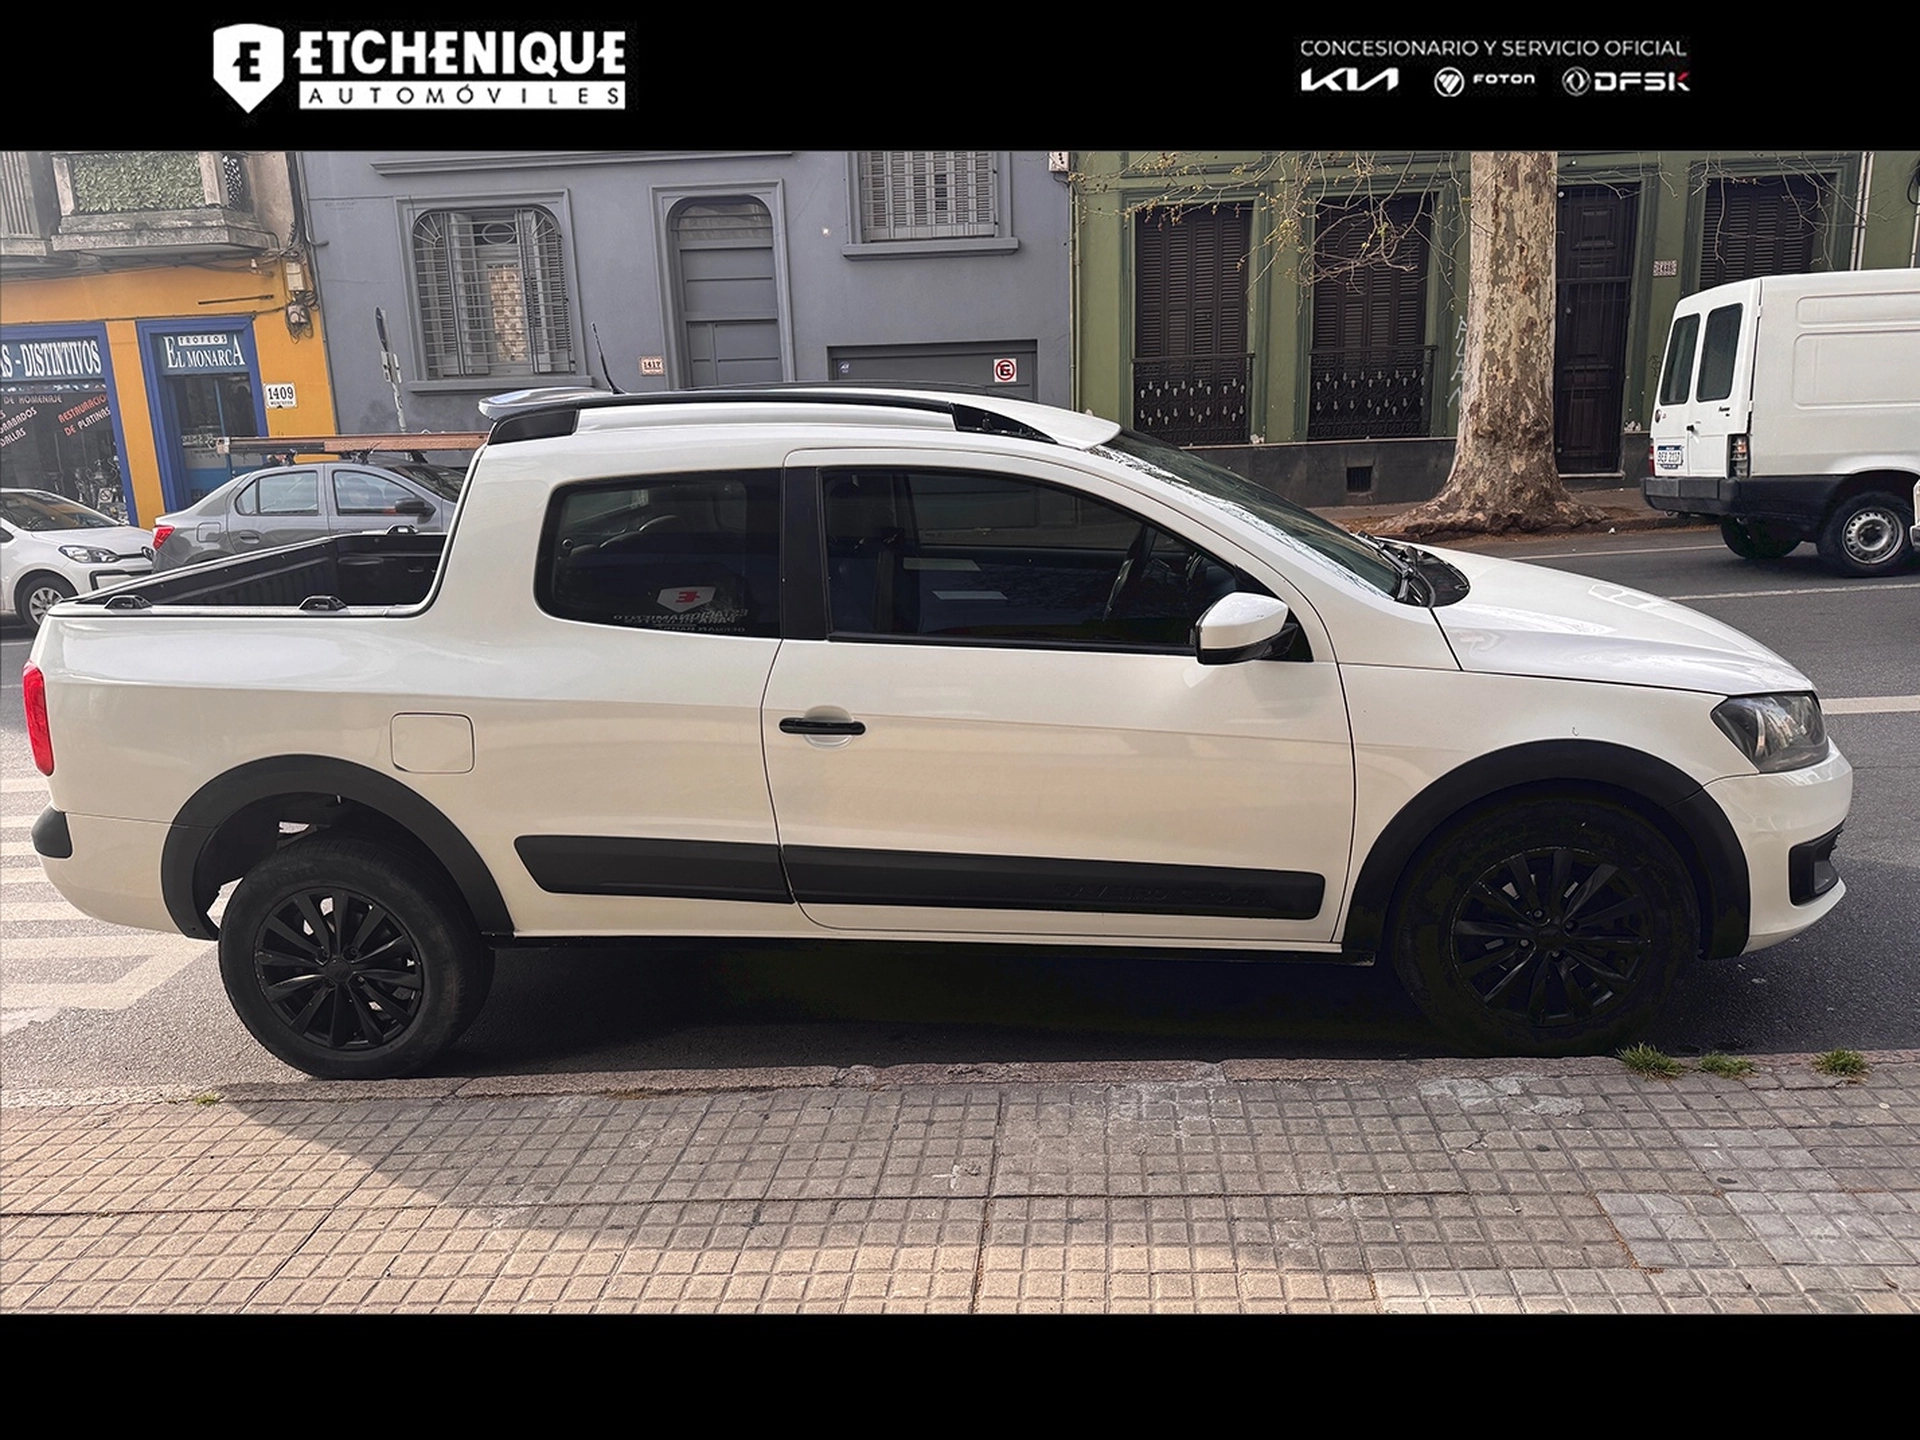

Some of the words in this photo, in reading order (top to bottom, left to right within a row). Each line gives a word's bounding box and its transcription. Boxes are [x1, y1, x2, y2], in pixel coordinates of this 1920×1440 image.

[163, 336, 186, 369] EL
[187, 334, 246, 368] MONARCA
[179, 335, 226, 345] TROFEOS
[20, 340, 102, 377] DISTINTIVOS
[3, 396, 15, 405] DE
[18, 394, 62, 405] HOMENAJE
[268, 386, 294, 400] 1409
[63, 424, 77, 437] DE
[77, 405, 111, 430] PLATINAS
